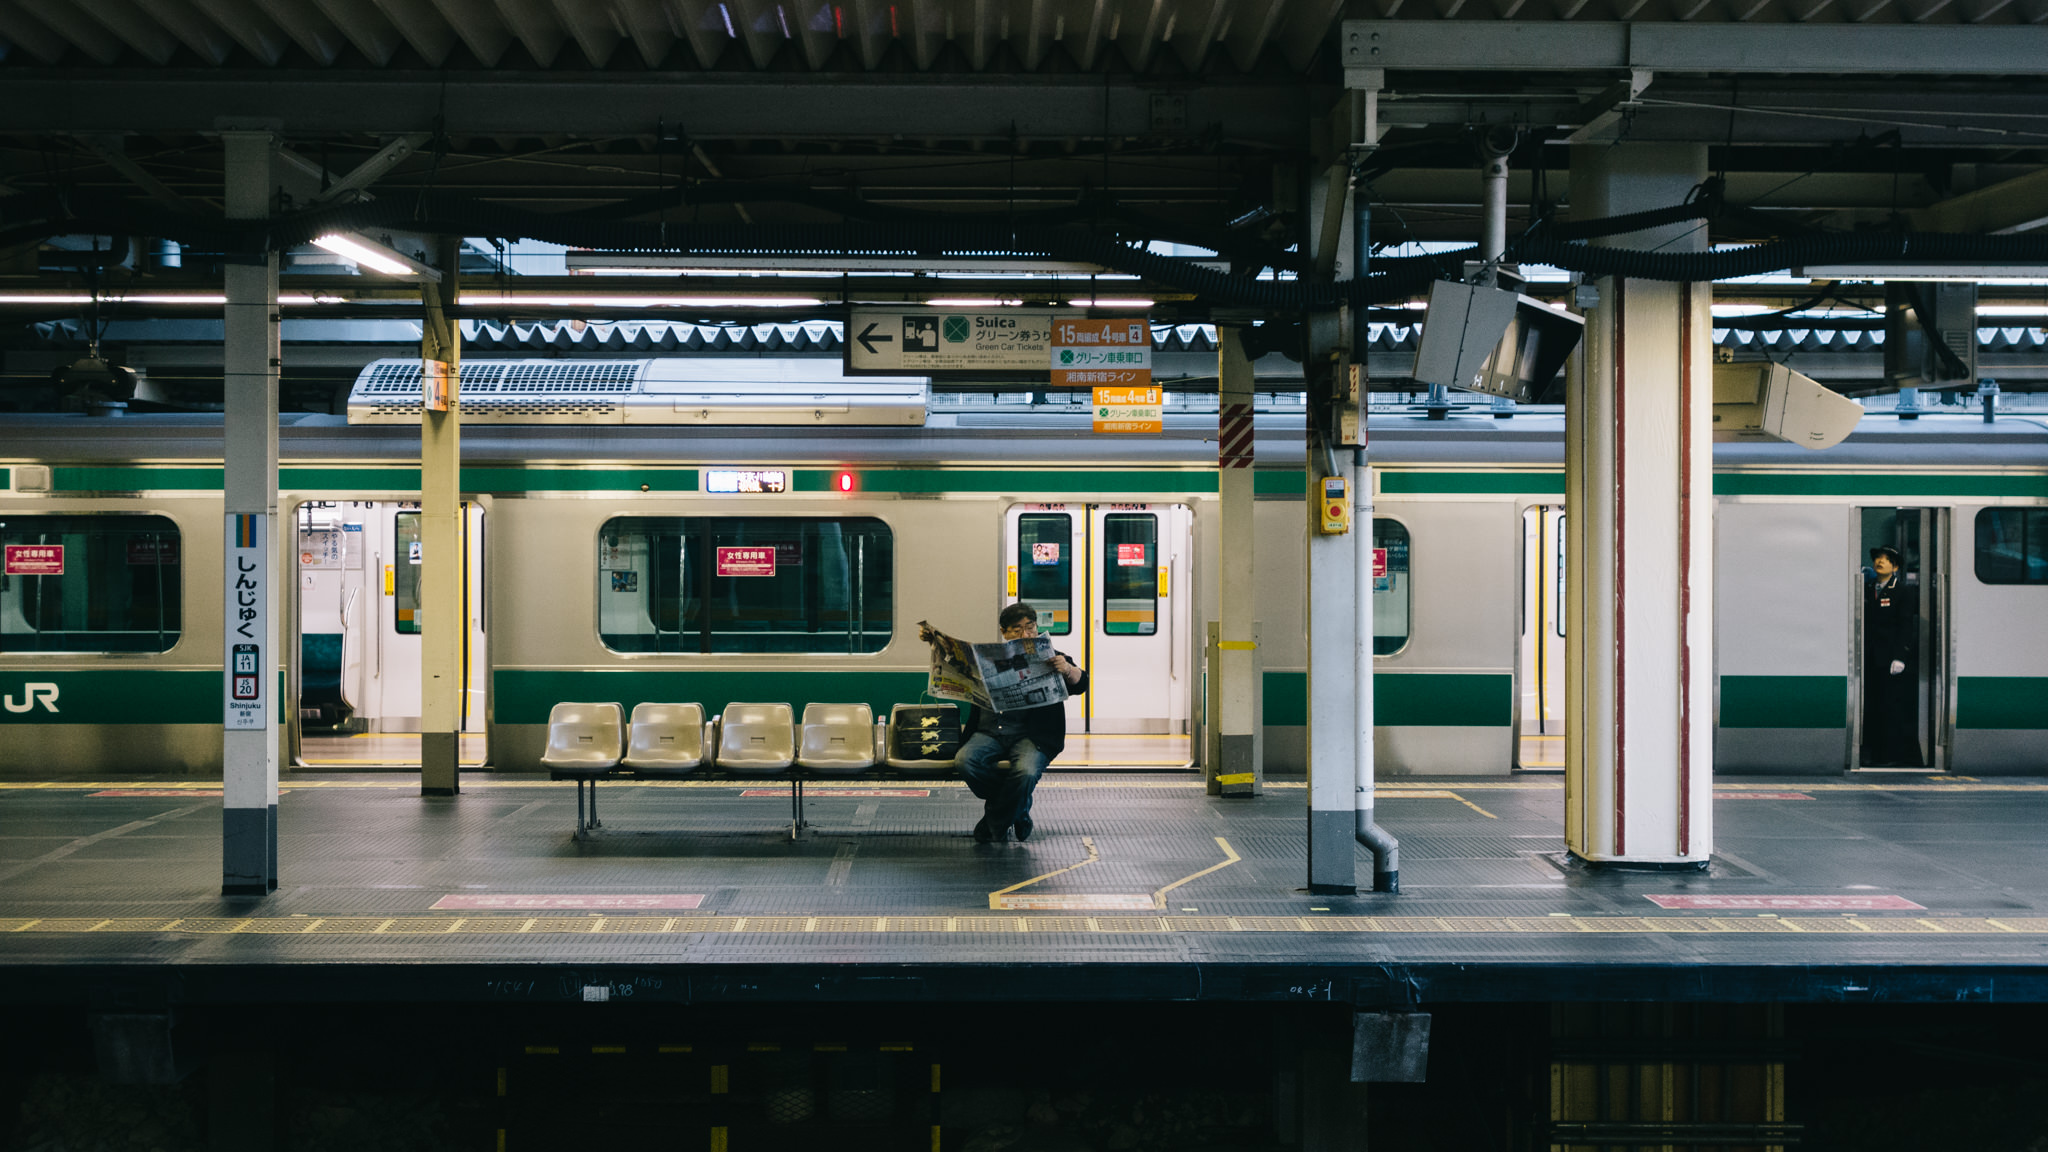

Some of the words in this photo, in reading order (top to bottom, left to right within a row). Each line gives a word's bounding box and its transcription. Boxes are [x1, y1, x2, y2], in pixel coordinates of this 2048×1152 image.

[975, 316, 1017, 328] Suica
[1131, 331, 1140, 342] 4
[975, 343, 999, 351] Green
[1001, 343, 1014, 351] Car
[1016, 343, 1044, 351] Tickets
[1075, 351, 1143, 365] グリーン車乗車口
[1065, 371, 1136, 383] 湘南新宿ライン
[15, 549, 56, 558] 女性専用車
[726, 551, 767, 560] 女性専用車
[235, 555, 257, 639] しんじゅく
[240, 661, 251, 670] 11
[239, 685, 252, 695] 20
[4, 682, 60, 713] JR
[230, 702, 261, 710] Shinjuku
